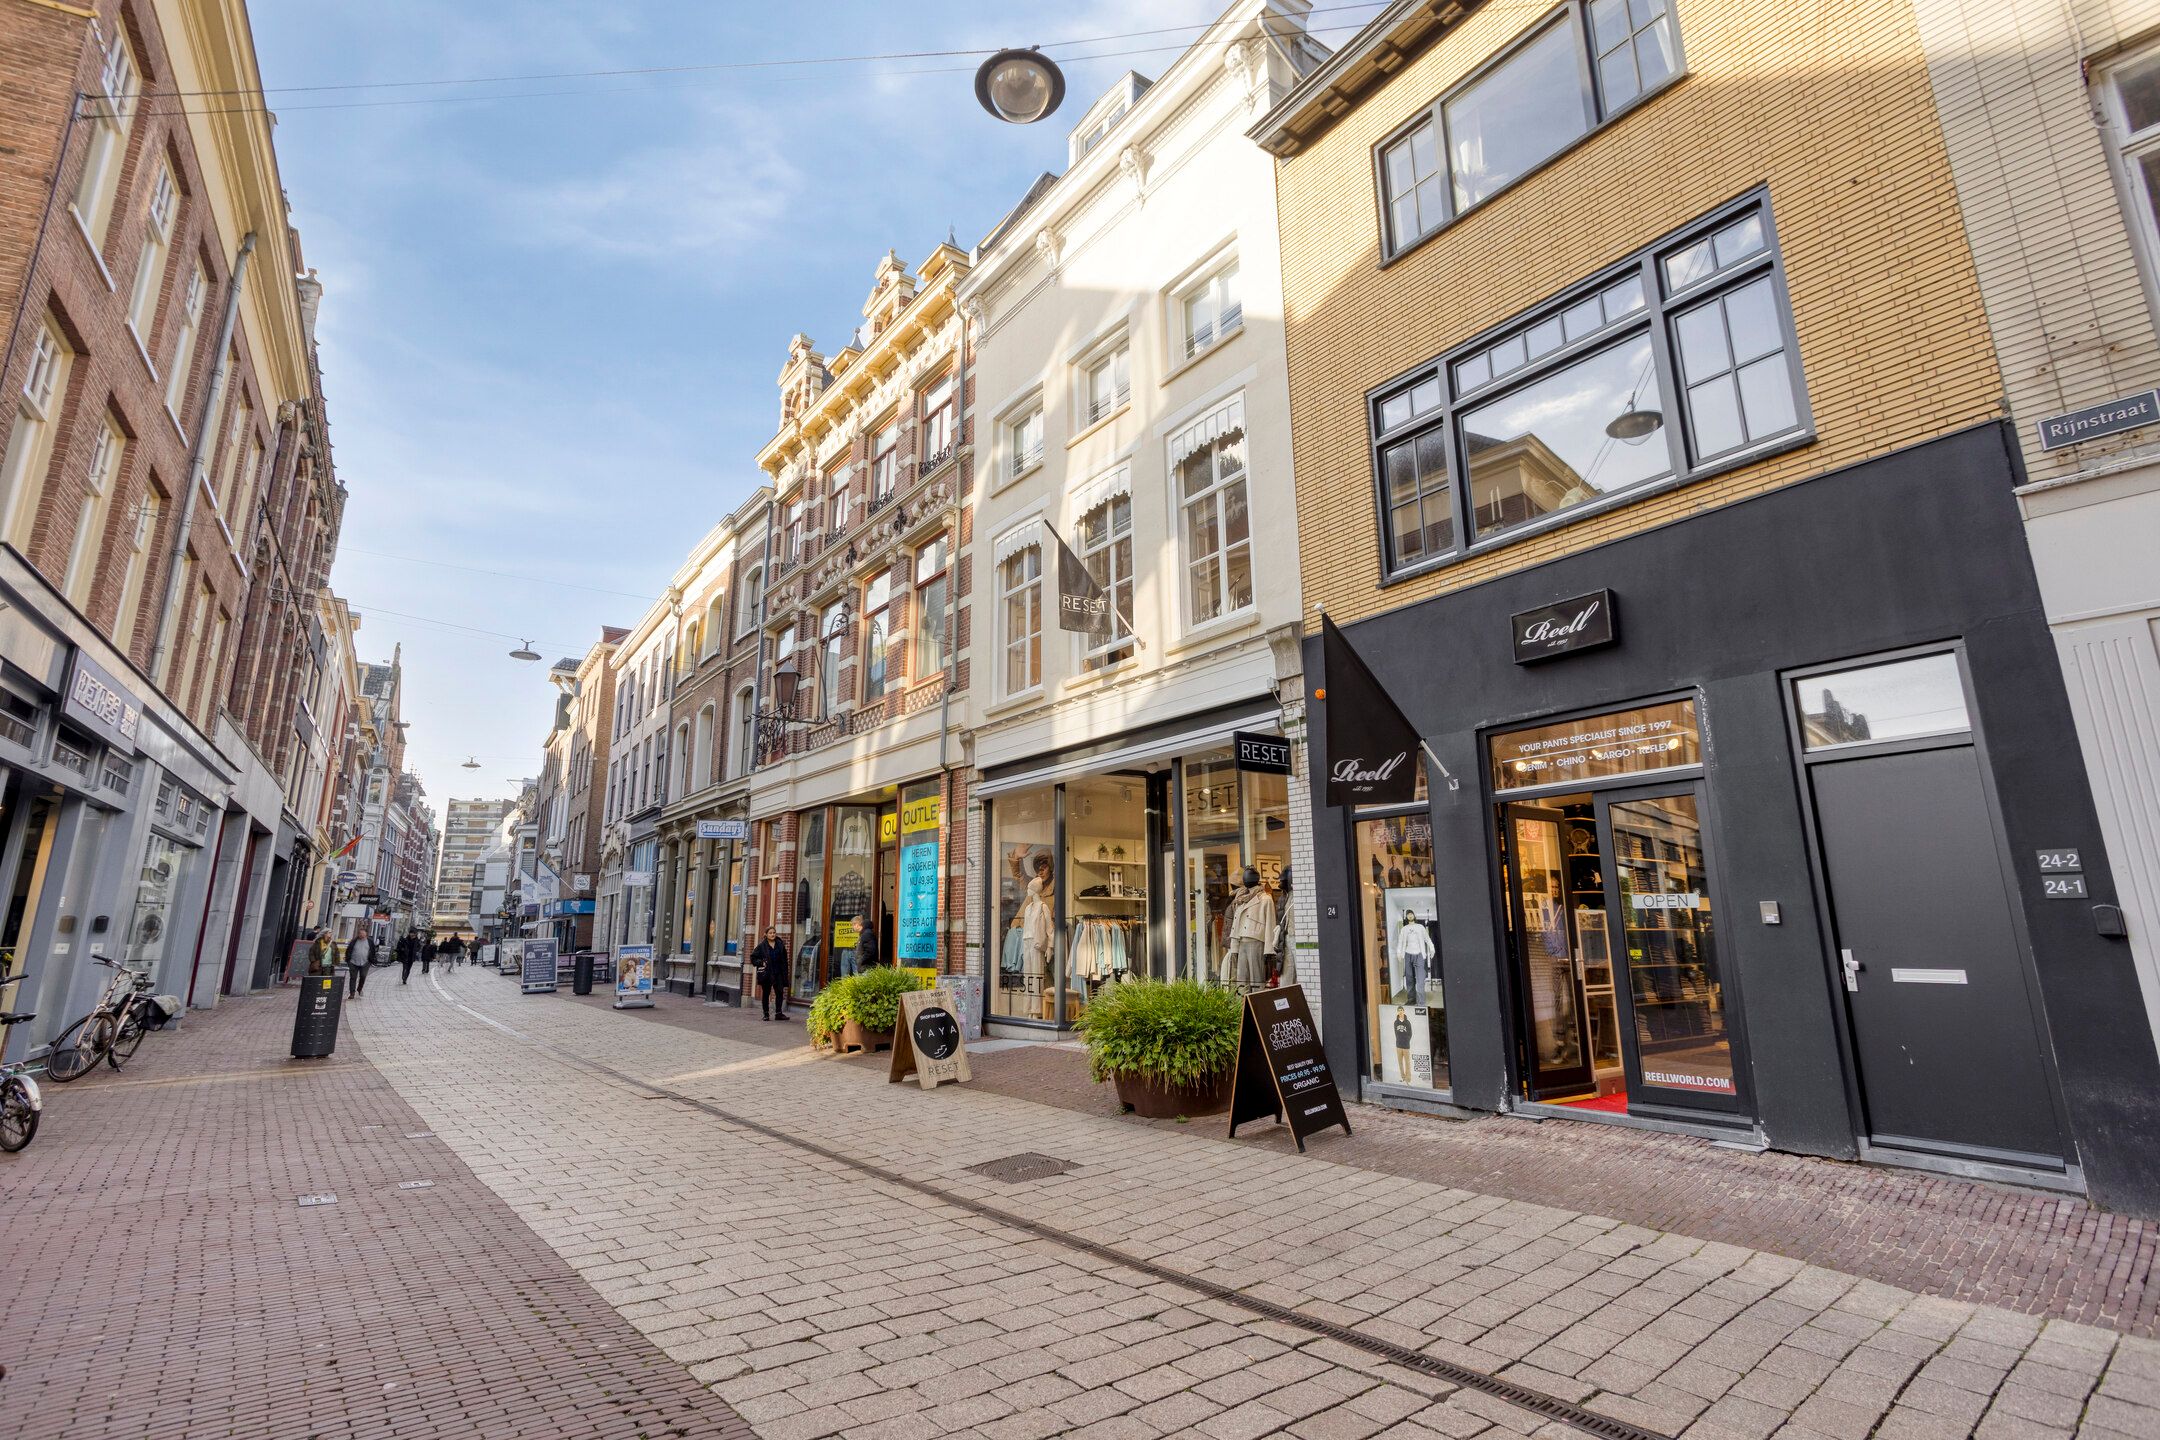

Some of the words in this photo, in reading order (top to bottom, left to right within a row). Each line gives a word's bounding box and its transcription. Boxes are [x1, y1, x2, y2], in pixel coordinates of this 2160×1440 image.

[2050, 402, 2149, 437] Rijnstraat
[1062, 596, 1107, 614] RESET
[1521, 600, 1600, 645] Reell
[1519, 740, 1542, 753] YOUR
[1542, 737, 1568, 749] PANTS
[1569, 728, 1616, 745] SPECIALIST
[1618, 724, 1646, 737] SINCE
[1648, 720, 1672, 732] 1997
[1241, 743, 1288, 763] RESET
[1556, 755, 1586, 767] CHINO
[1596, 748, 1630, 760] CARGO
[1331, 752, 1406, 782] Reell
[701, 822, 742, 836] Sunday's
[912, 846, 932, 858] HEREN
[908, 860, 936, 872] BROEKEN
[2039, 854, 2080, 868] 24-2
[910, 877, 917, 886] NU
[2045, 880, 2082, 894] 24-1
[1643, 894, 1689, 908] OPEN
[1327, 907, 1336, 916] 24
[902, 917, 920, 928] SUPER
[906, 943, 934, 953] BROEKEN
[1002, 975, 1044, 994] RESET
[916, 1025, 957, 1039] YAYA
[1270, 1032, 1279, 1042] OF
[1280, 1024, 1310, 1040] PREMIUM
[1272, 1023, 1280, 1034] 27
[1280, 1018, 1302, 1031] YEARS
[1272, 1032, 1312, 1051] STREETWEAR
[928, 1062, 959, 1076] RESET
[1280, 1072, 1297, 1083] PRICES
[1292, 1076, 1320, 1090] ORGANIC
[1644, 1071, 1730, 1088] REELLWORLD.COM
